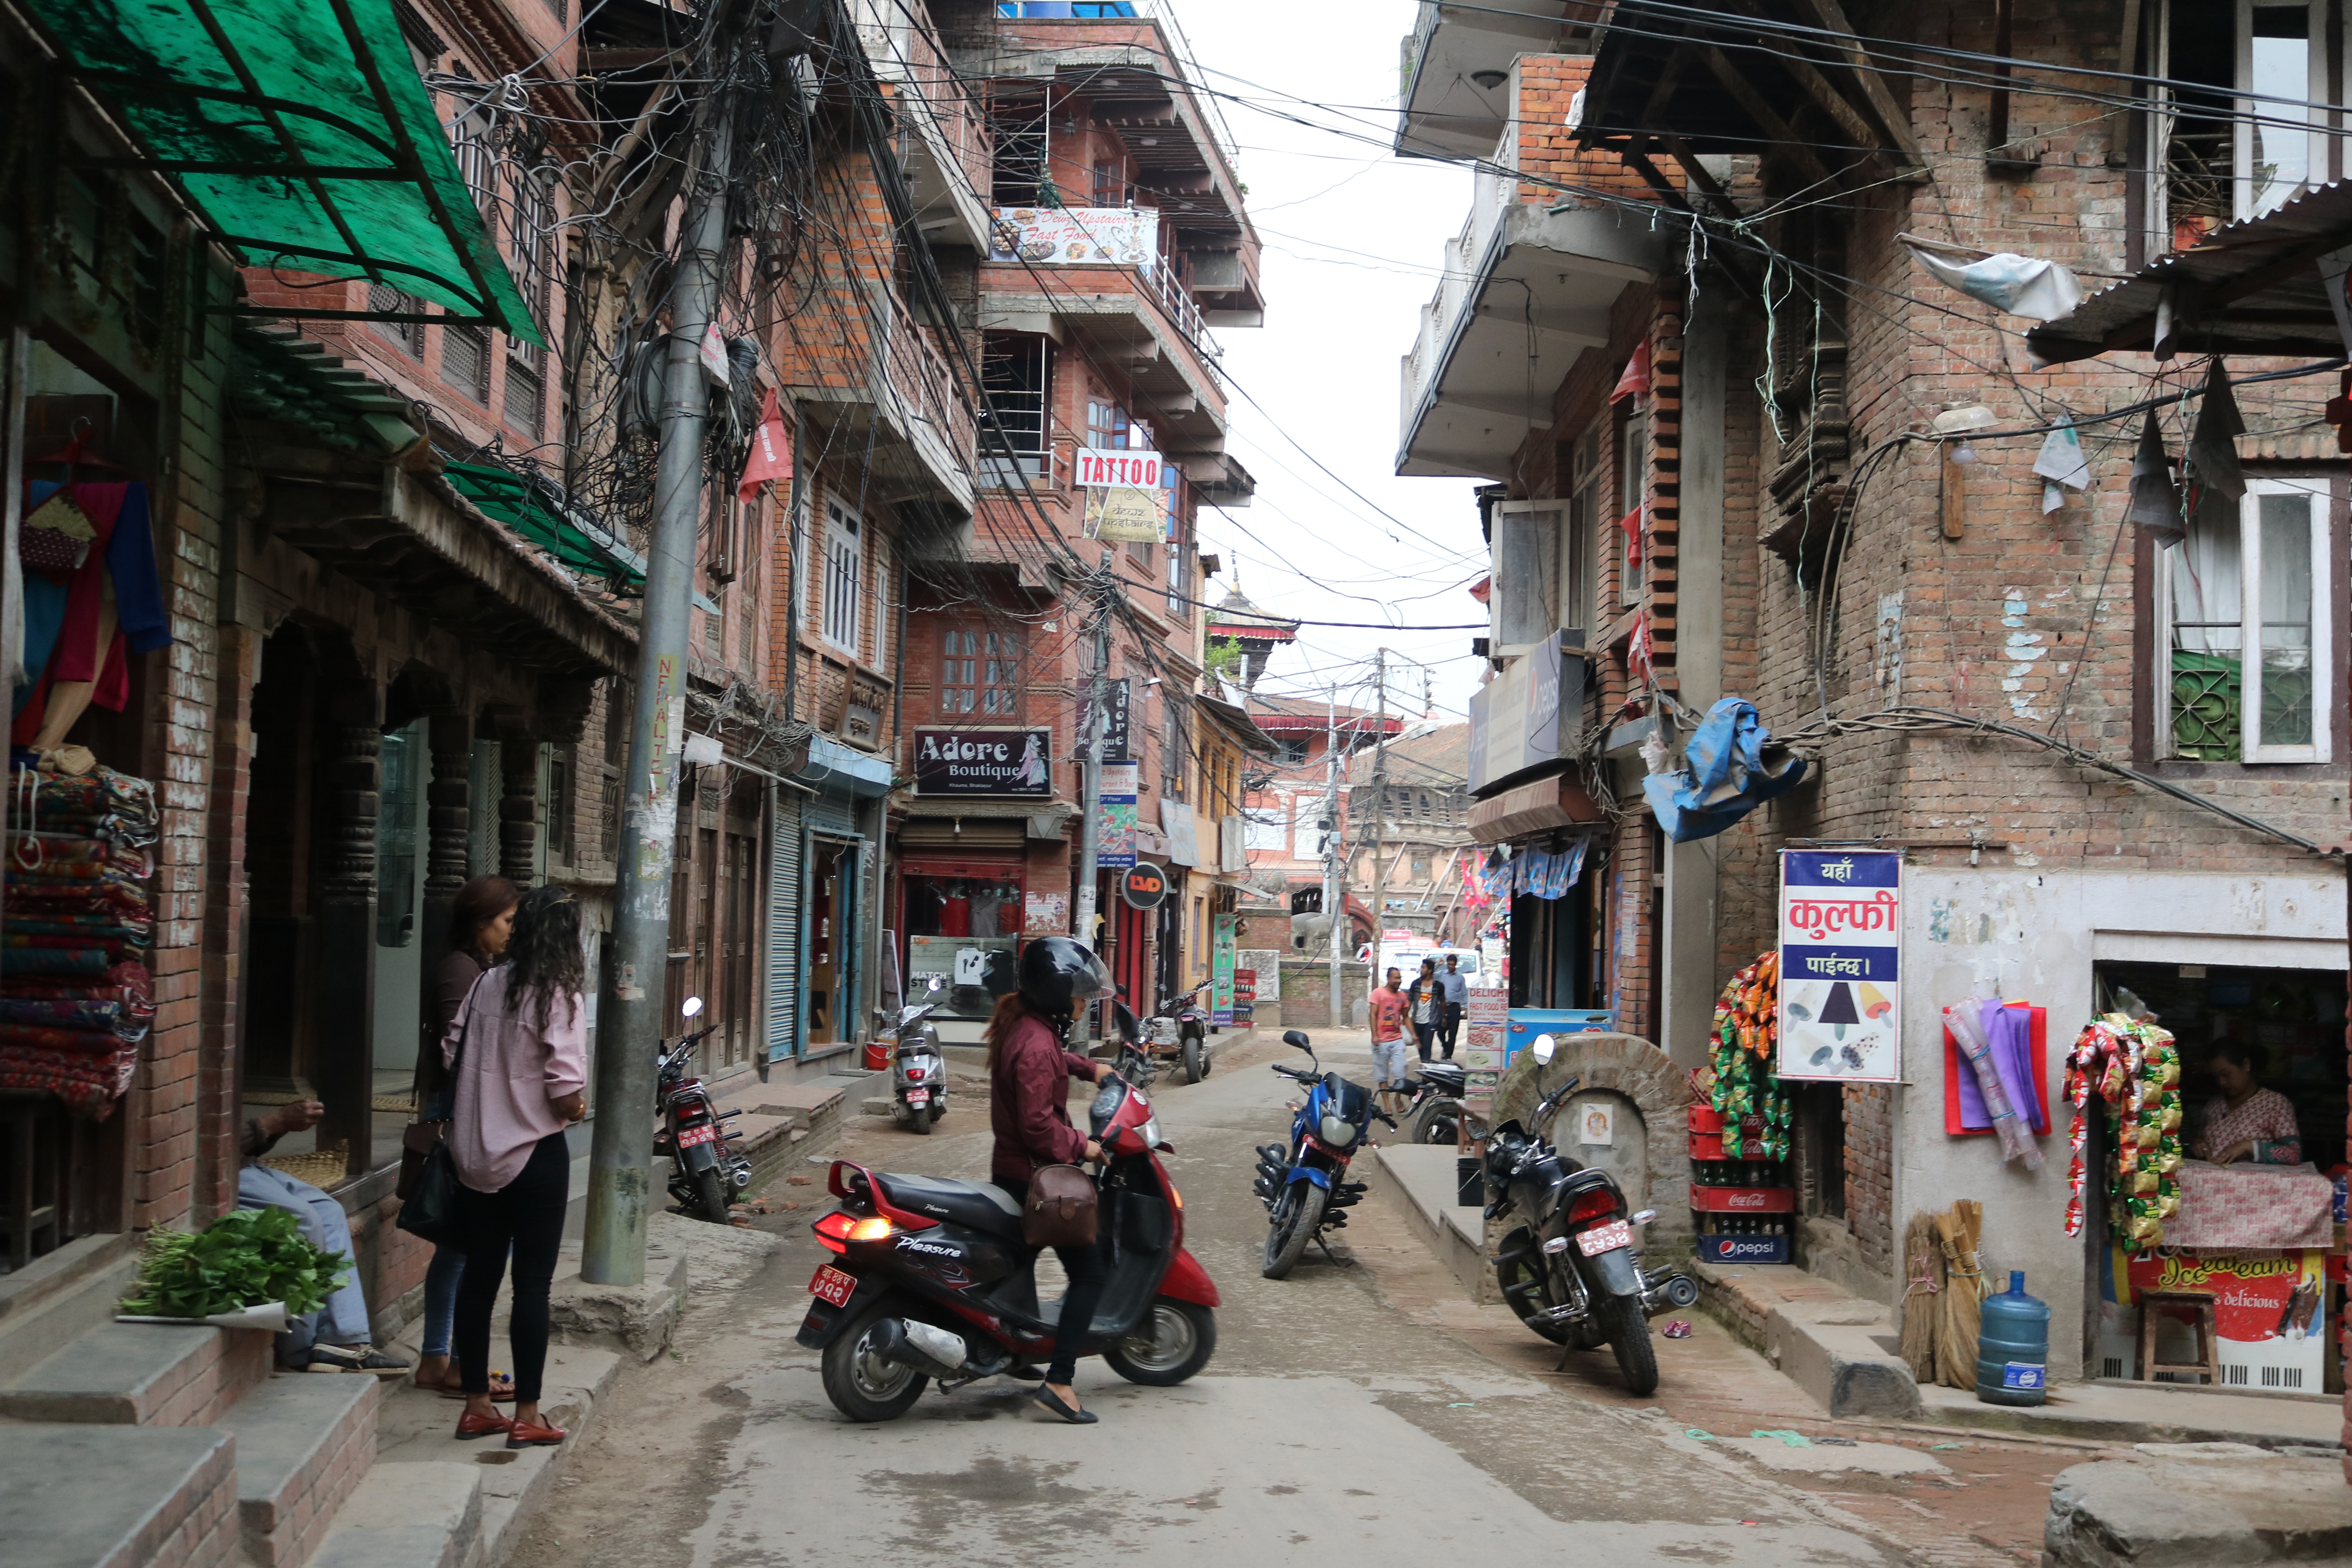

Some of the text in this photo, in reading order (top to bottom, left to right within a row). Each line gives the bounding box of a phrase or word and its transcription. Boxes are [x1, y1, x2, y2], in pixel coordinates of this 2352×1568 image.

[1041, 211, 1127, 227] Dewz Upstairs
[1026, 227, 1097, 243] Fast Food
[1082, 457, 1156, 485] TATTOO
[920, 736, 1010, 761] Adore
[949, 763, 1020, 780] Boutique
[1820, 856, 1854, 883] यहाँ
[1081, 890, 1095, 900] +2
[1789, 890, 1898, 940] कुल्फी
[911, 971, 947, 979] MATCH
[1470, 988, 1509, 997] DELIGHT
[924, 1203, 949, 1213] Pleasure
[895, 1236, 961, 1258] Pleasure
[1737, 1242, 1775, 1255] pepsi
[2224, 1289, 2280, 1309] delicious
